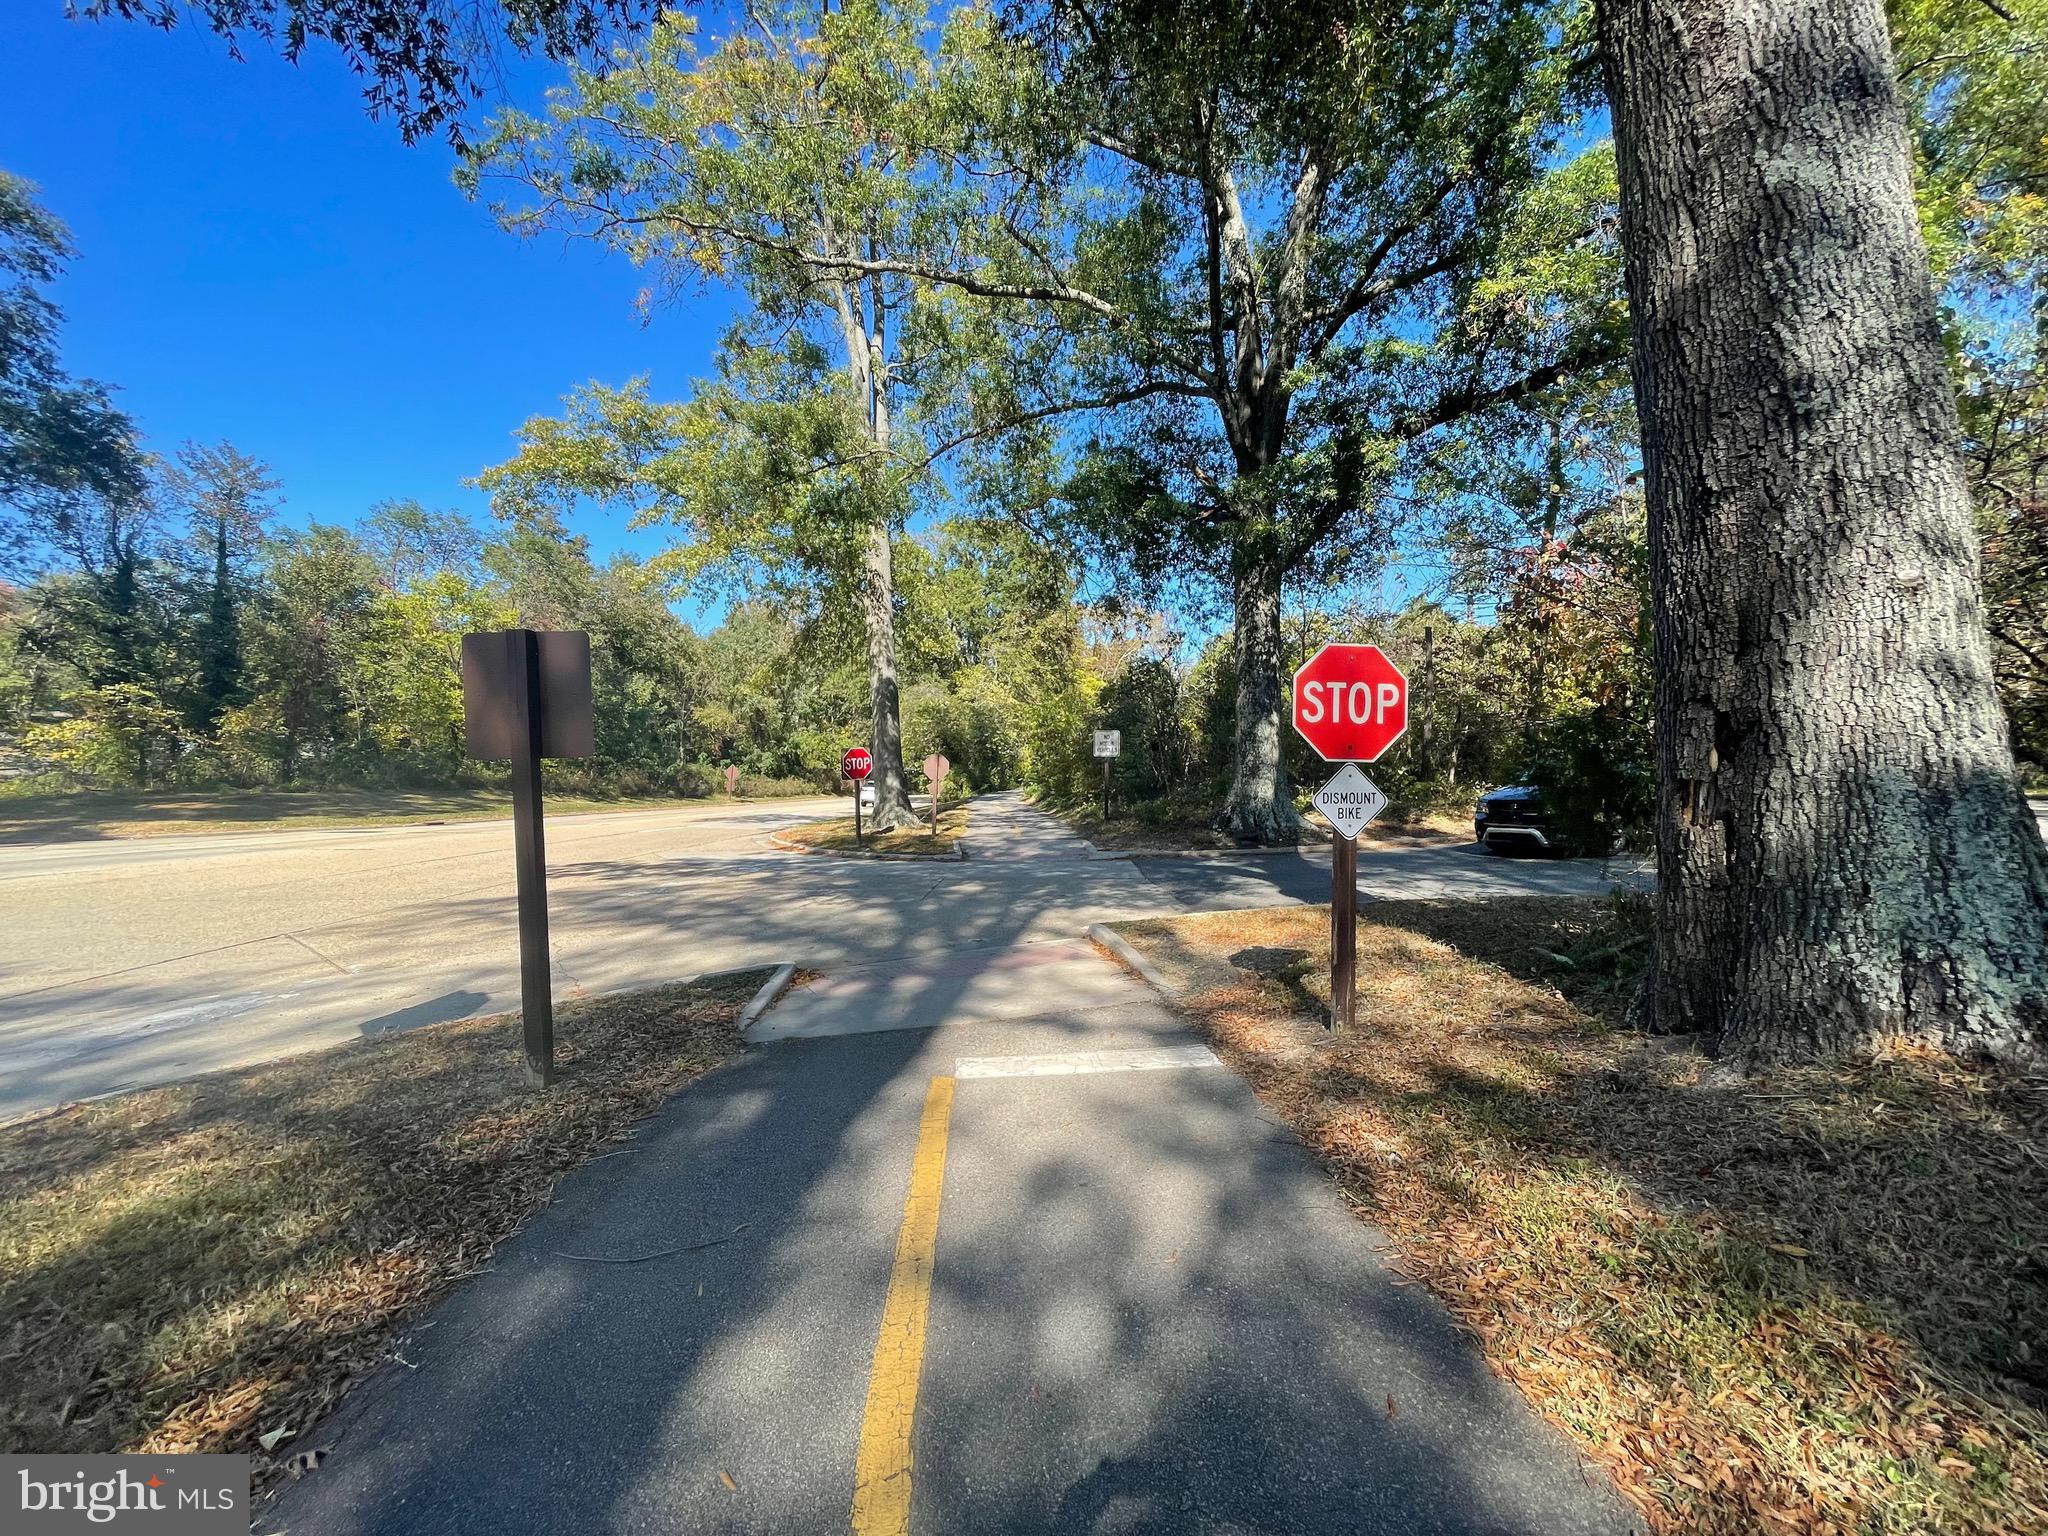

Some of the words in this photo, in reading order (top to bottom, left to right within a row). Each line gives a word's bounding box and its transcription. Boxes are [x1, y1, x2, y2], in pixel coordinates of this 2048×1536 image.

[1302, 680, 1400, 725] STOP
[845, 757, 870, 770] STOP
[1322, 792, 1377, 804] DISMOUNT
[1337, 807, 1362, 819] BIKE
